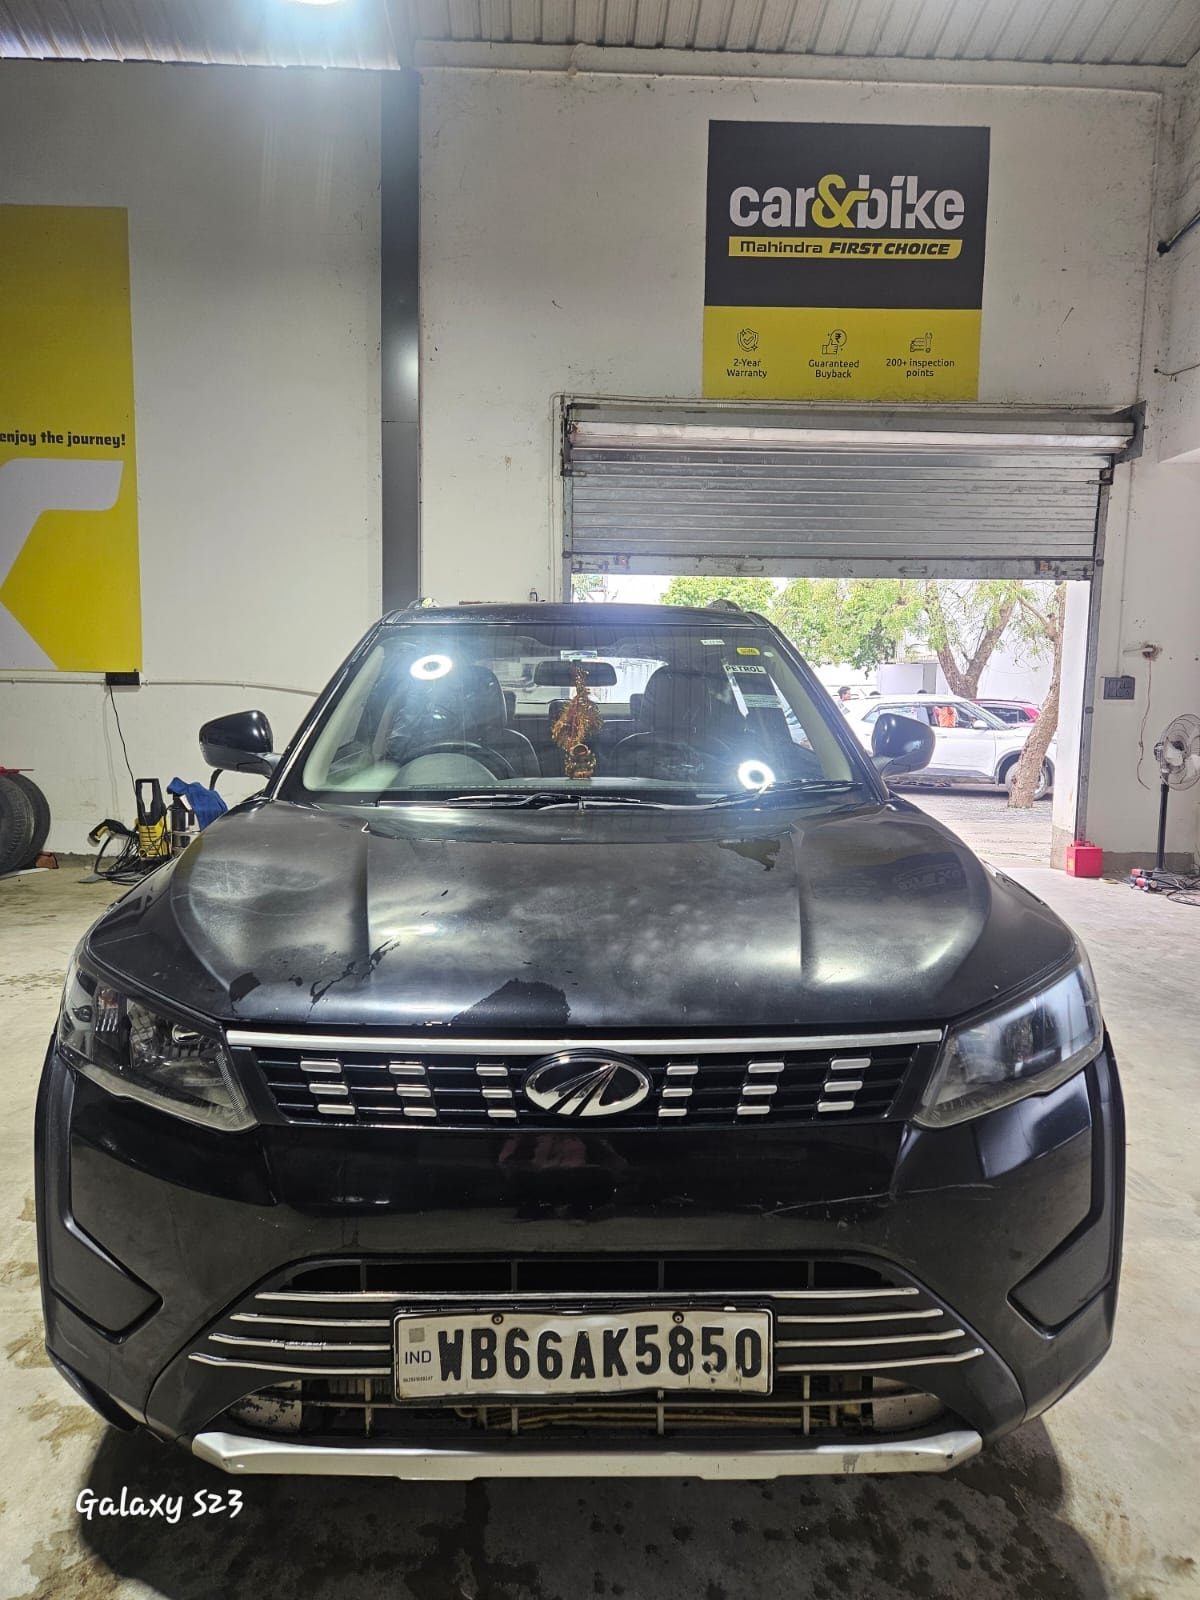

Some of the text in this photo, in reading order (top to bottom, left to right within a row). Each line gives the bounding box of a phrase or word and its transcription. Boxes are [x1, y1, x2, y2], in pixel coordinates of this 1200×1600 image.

[729, 174, 965, 230] car&bike
[740, 240, 951, 255] Mahindra FIRST CHOICE
[733, 359, 761, 367] 2-Year
[808, 359, 860, 369] Guaranteed
[886, 359, 955, 369] 200+ inspection
[726, 369, 768, 379] Warranty
[815, 369, 852, 379] Buyback
[906, 369, 934, 379] points
[0, 430, 126, 448] enjoy the journey!
[725, 665, 764, 673] PETROL
[405, 1350, 432, 1365] IND
[437, 1324, 762, 1381] WB66AK5850
